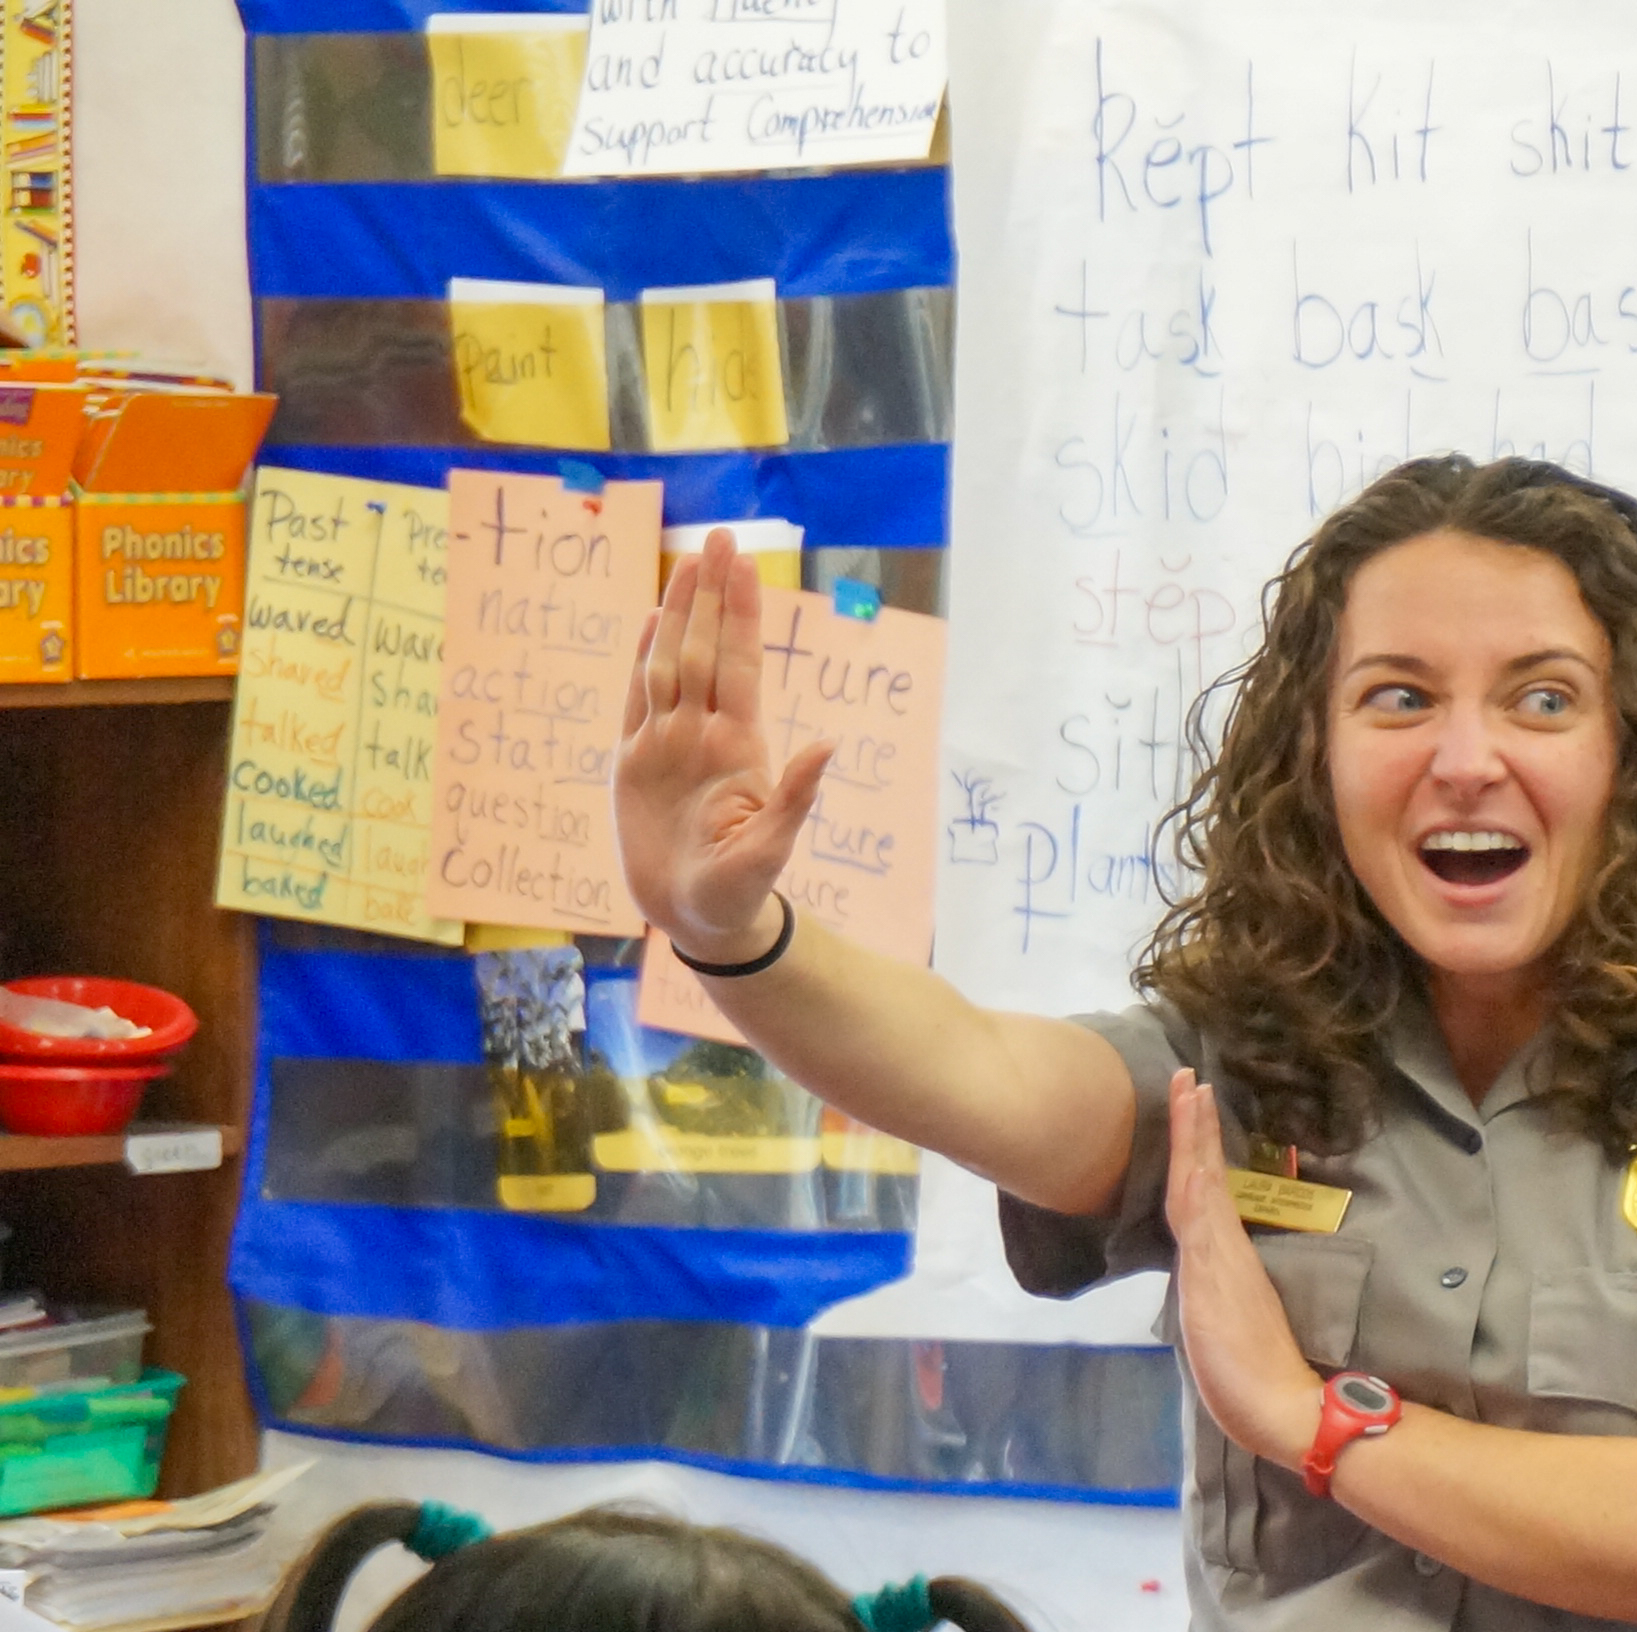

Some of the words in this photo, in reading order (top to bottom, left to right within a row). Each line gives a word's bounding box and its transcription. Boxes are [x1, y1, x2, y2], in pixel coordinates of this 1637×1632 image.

[587, 31, 667, 91] and
[694, 37, 858, 104] accuracy
[889, 6, 931, 64] to
[1054, 260, 1223, 373] task
[1291, 236, 1445, 369] bask
[102, 526, 225, 560] Phonics
[262, 492, 349, 542] Past
[104, 565, 222, 608] Library
[477, 588, 622, 647] nation
[450, 653, 600, 718] action
